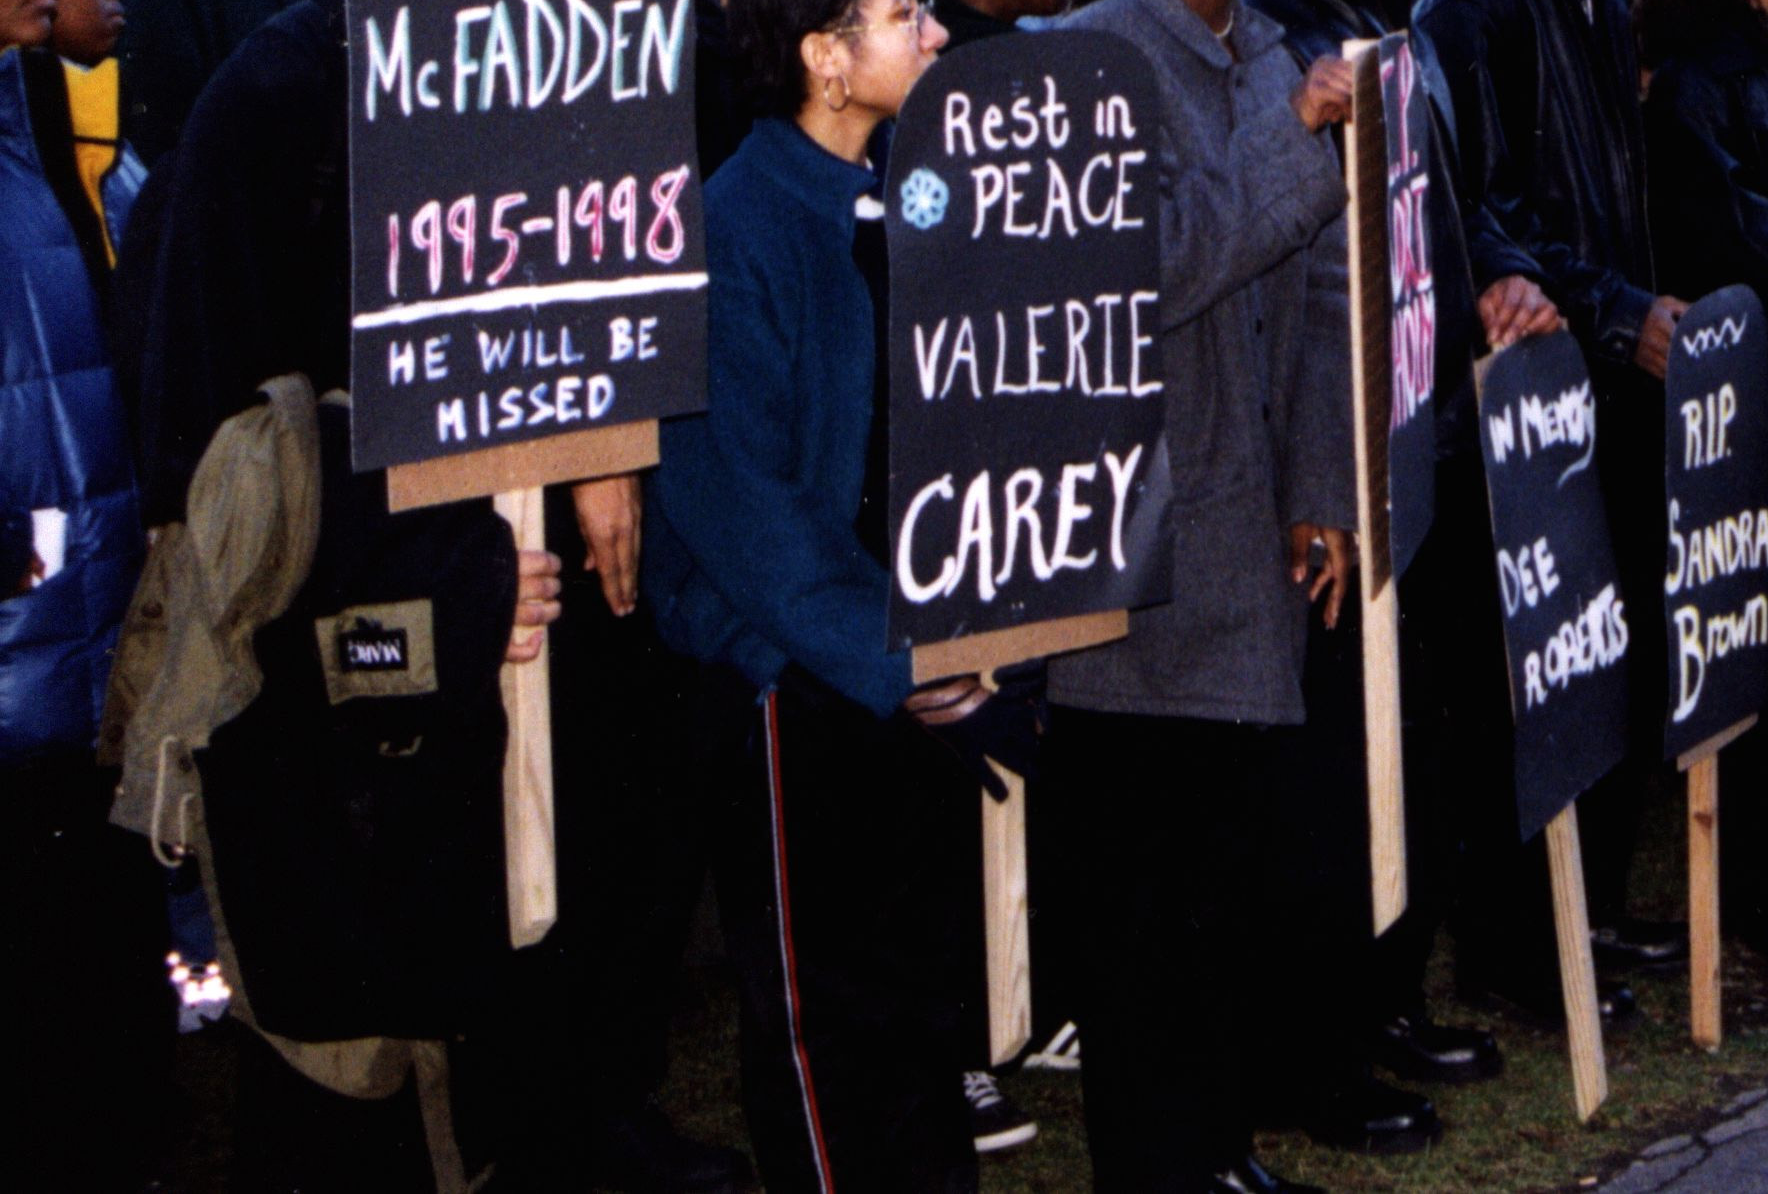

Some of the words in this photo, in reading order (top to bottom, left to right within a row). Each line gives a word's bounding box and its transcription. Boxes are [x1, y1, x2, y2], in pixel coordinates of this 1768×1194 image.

[944, 75, 1070, 156] Rest
[1096, 70, 1136, 138] in
[388, 165, 689, 296] 1995-1998
[972, 151, 1146, 238] PEACE
[388, 335, 449, 385] HE
[477, 325, 583, 374] WILL
[609, 317, 659, 360] BE
[915, 292, 1163, 400] VALERIE
[438, 375, 615, 443] MISSED
[1489, 405, 1514, 464] IN
[898, 445, 1143, 603] CAREY
[1497, 536, 1561, 617] DEE
[1524, 582, 1629, 709] ROBERTS
[1673, 595, 1768, 724] Brown
